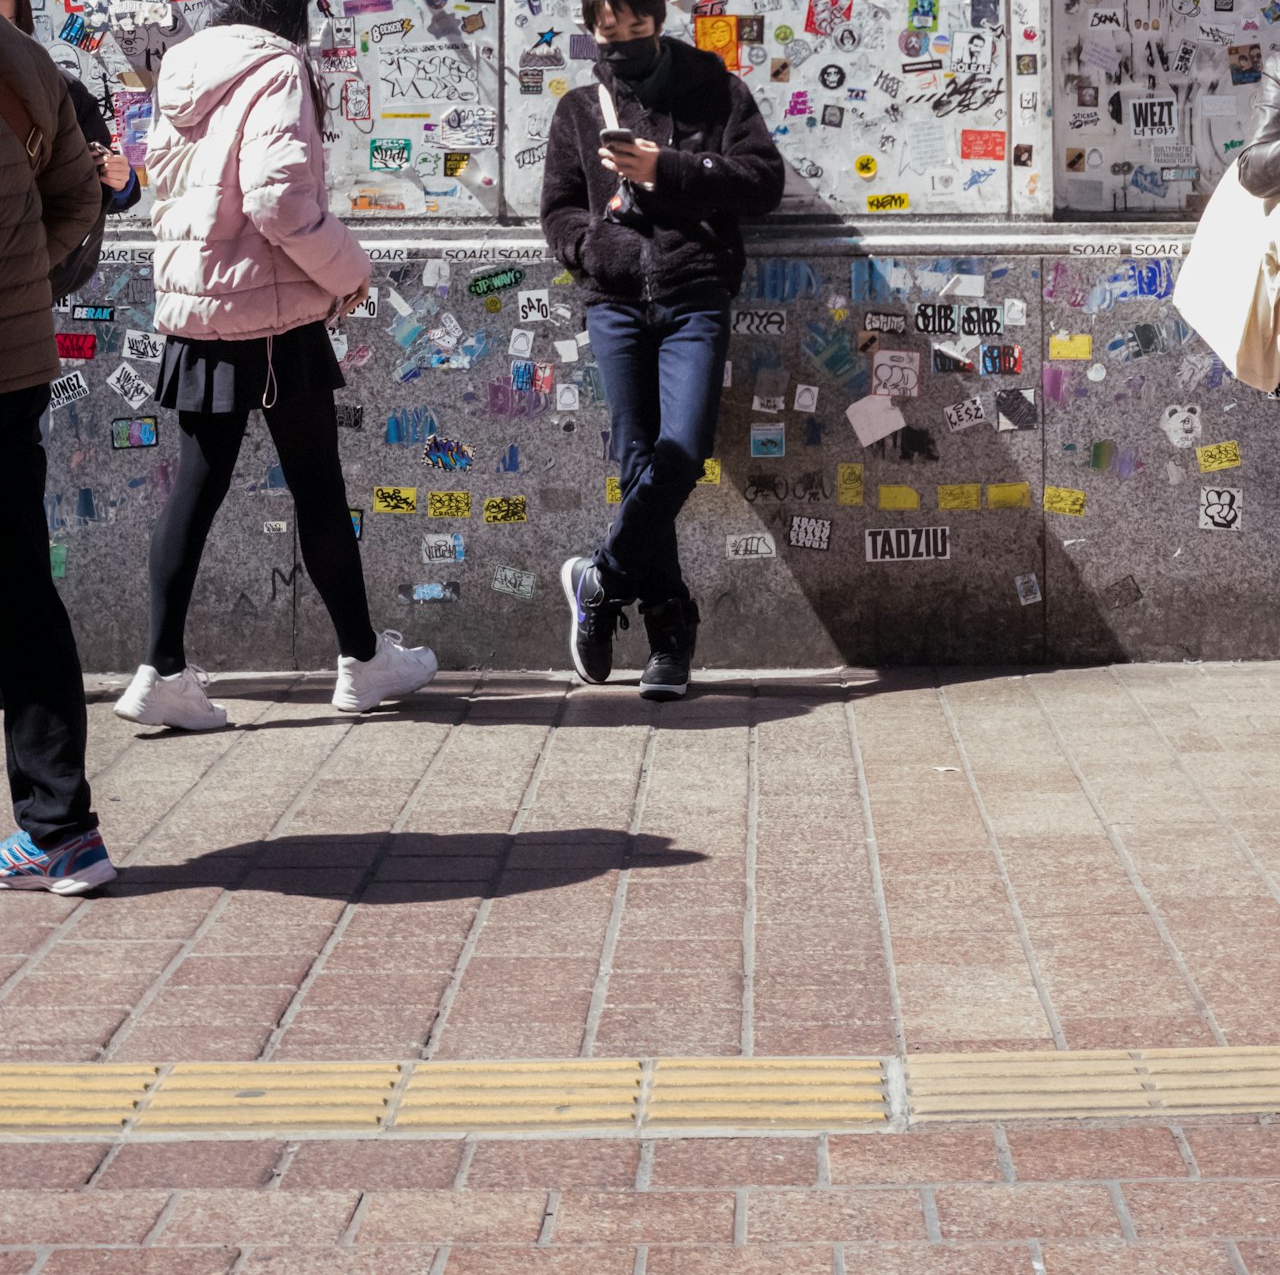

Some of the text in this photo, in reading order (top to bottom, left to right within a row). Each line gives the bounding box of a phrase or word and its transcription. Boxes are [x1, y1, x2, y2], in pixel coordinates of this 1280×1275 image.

[1132, 100, 1174, 128] WEZT
[444, 249, 543, 262] SOAR SOAR
[1072, 243, 1117, 256] SOAR
[1133, 243, 1179, 256] SOAR
[73, 307, 112, 320] BERAK
[521, 296, 549, 320] SATO
[868, 528, 948, 560] TADZIU
